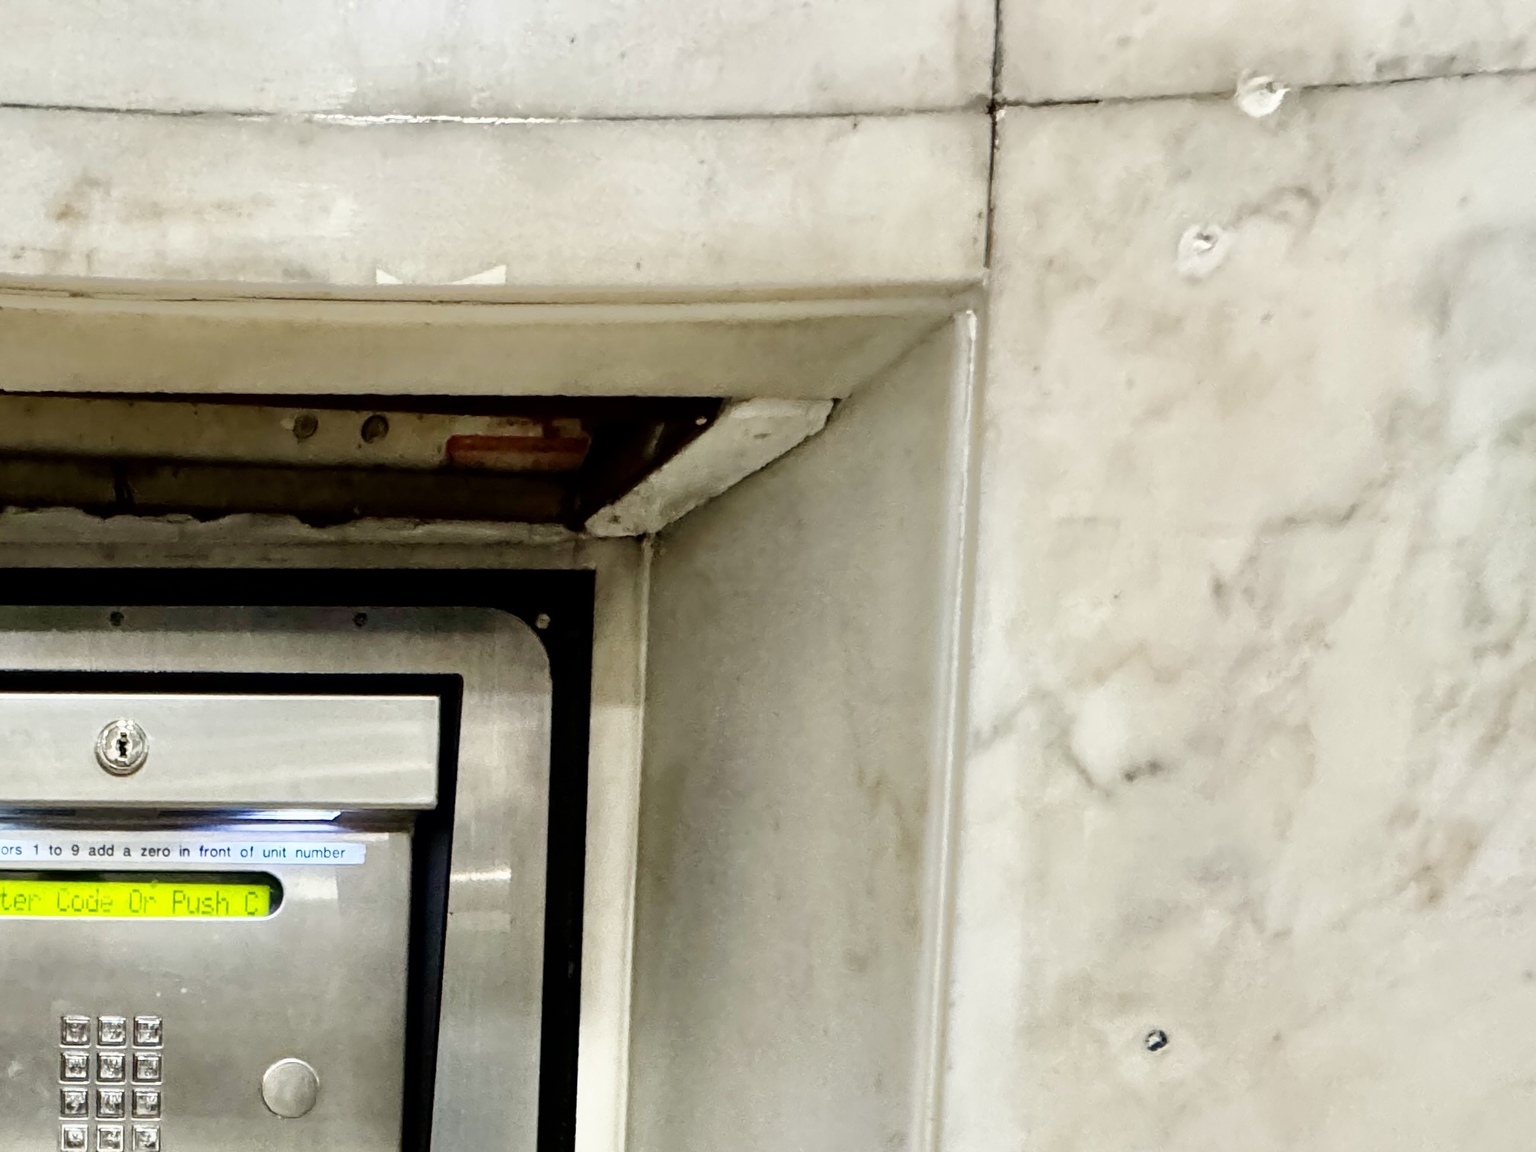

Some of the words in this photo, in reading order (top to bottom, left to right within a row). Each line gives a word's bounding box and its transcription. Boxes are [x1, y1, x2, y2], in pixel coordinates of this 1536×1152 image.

[34, 844, 40, 856] 1
[49, 845, 63, 856] to
[71, 845, 80, 856] 9
[88, 844, 114, 857] add
[123, 847, 132, 857] a
[140, 846, 171, 857] zero
[179, 845, 191, 857] in
[199, 845, 232, 858] front
[240, 846, 254, 858] of
[262, 846, 287, 858] unit
[295, 846, 346, 859] number
[56, 888, 114, 913] Code
[128, 888, 157, 914] Or
[172, 889, 230, 915] Push
[244, 891, 259, 916] C
